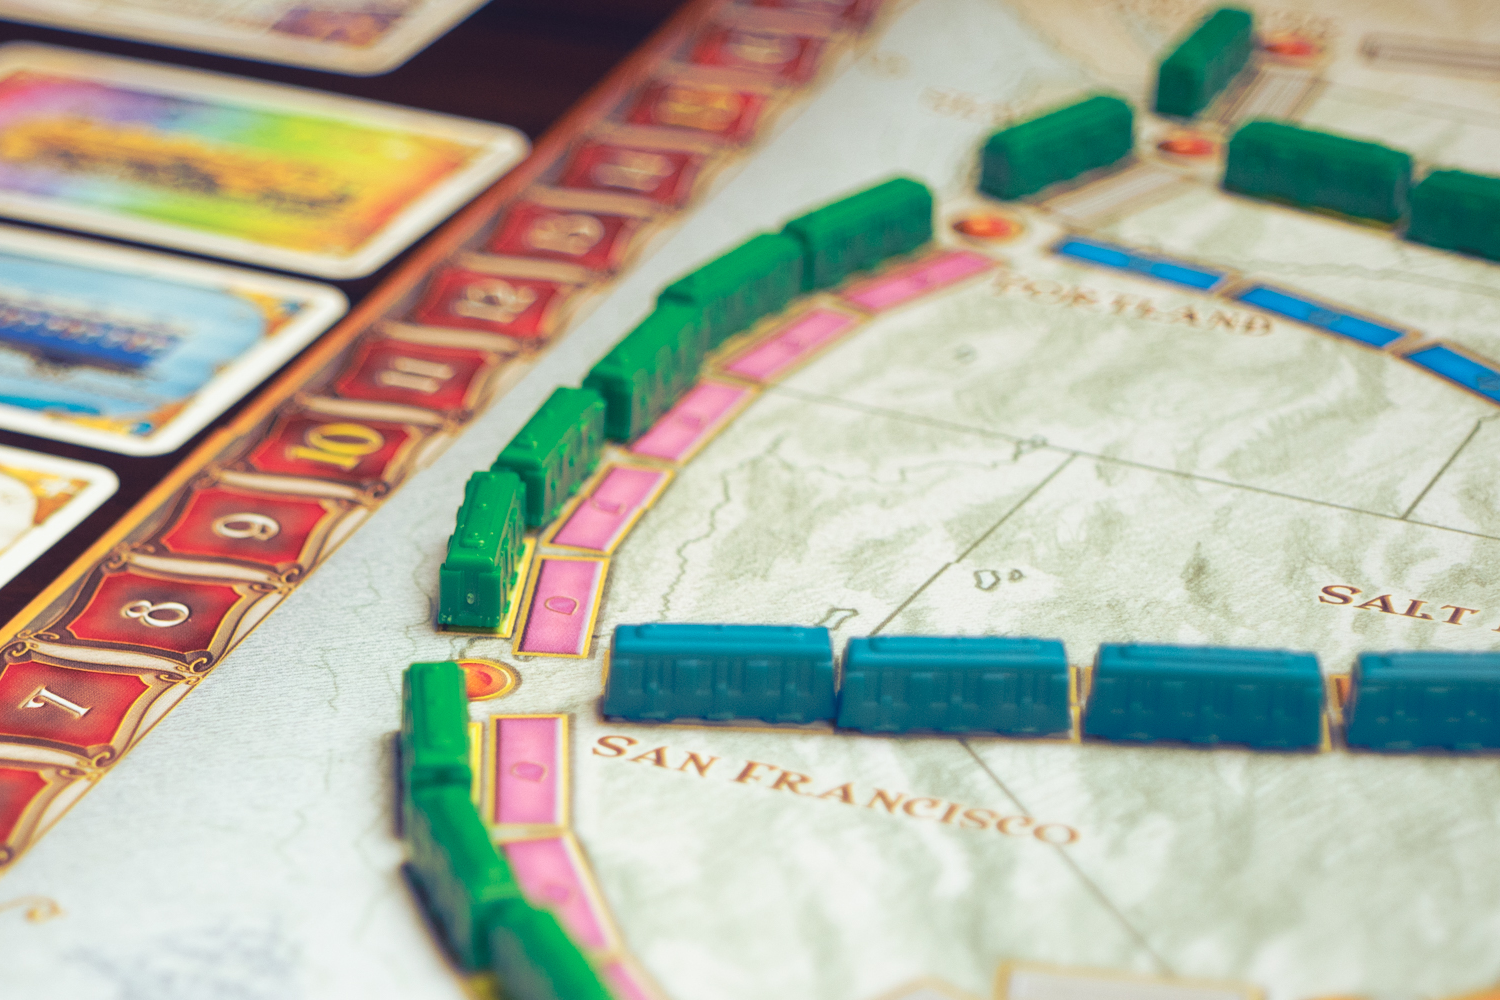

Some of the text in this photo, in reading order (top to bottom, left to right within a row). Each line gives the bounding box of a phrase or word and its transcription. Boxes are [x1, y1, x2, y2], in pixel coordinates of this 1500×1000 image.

[992, 271, 1272, 337] PORTLAND
[378, 355, 455, 394] 11
[285, 421, 385, 470] 10
[211, 512, 281, 541] 9
[120, 599, 191, 628] 8
[1317, 584, 1481, 626] SALT
[17, 684, 92, 719] 7
[591, 734, 1081, 847] SAN FRANCISCO
